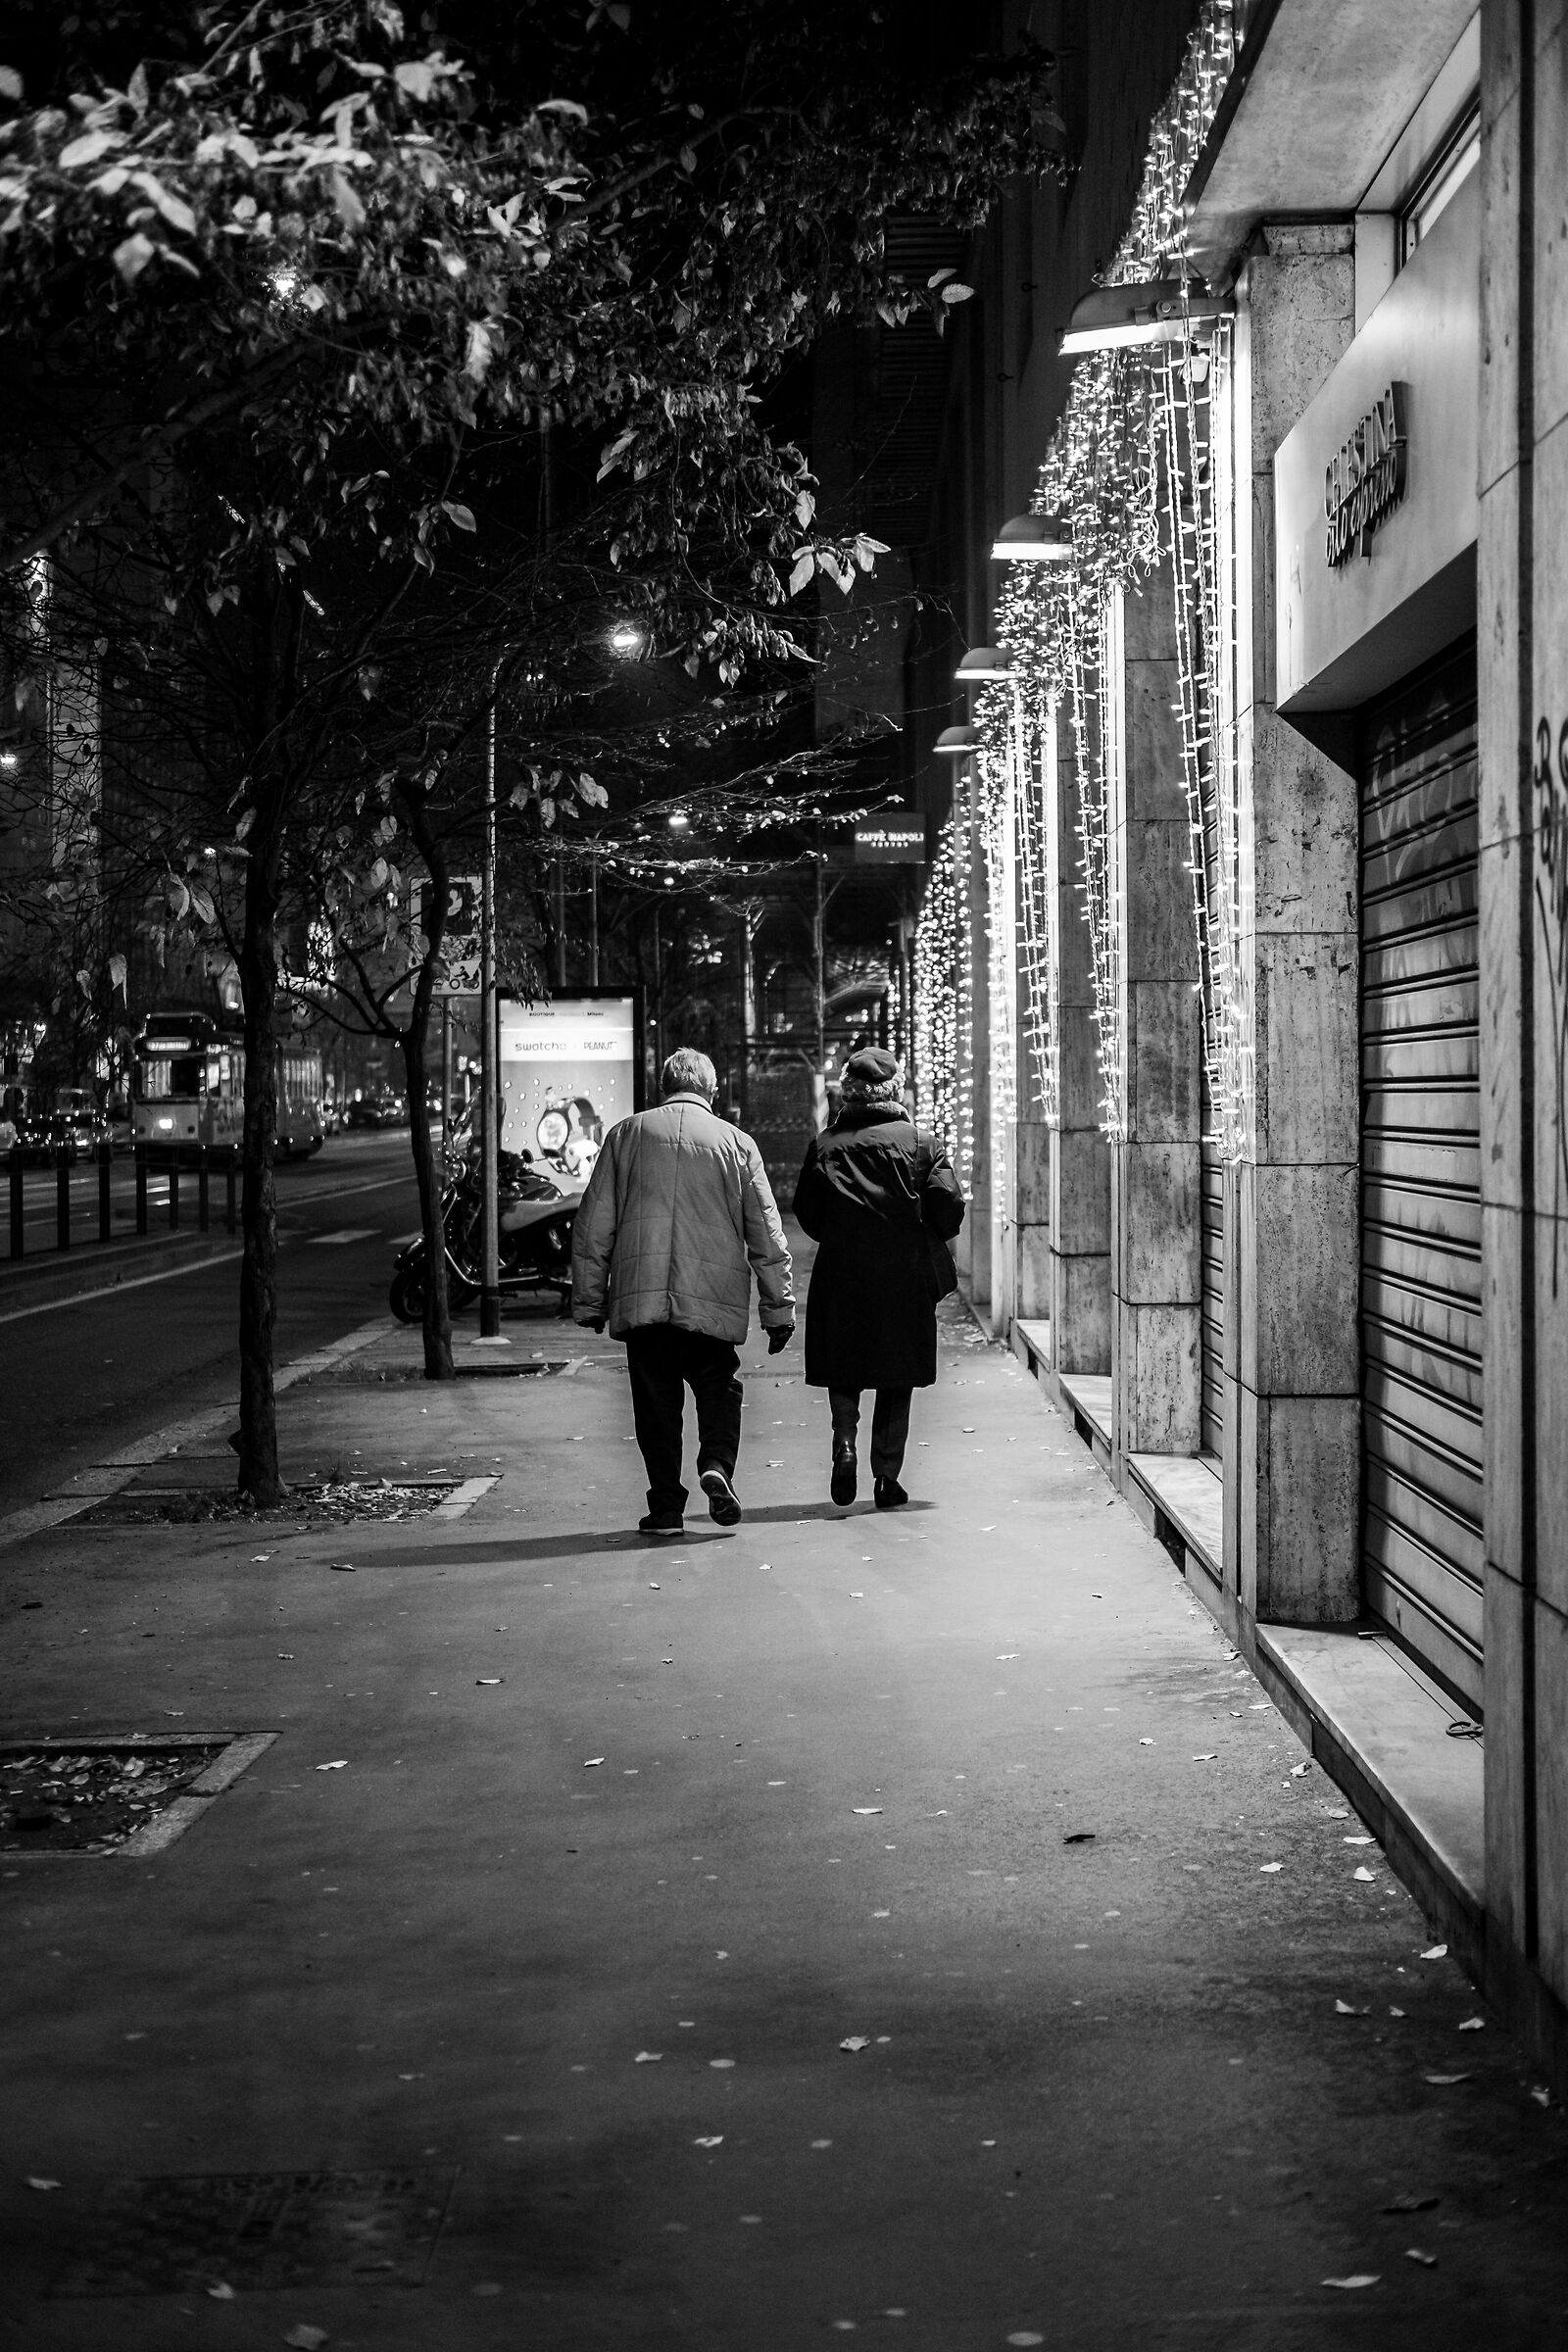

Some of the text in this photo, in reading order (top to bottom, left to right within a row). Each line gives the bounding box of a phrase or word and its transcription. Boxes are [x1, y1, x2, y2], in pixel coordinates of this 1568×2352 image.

[1325, 381, 1399, 522] CELESTINA
[887, 832, 924, 842] NAPOLI
[515, 1042, 559, 1051] swatch
